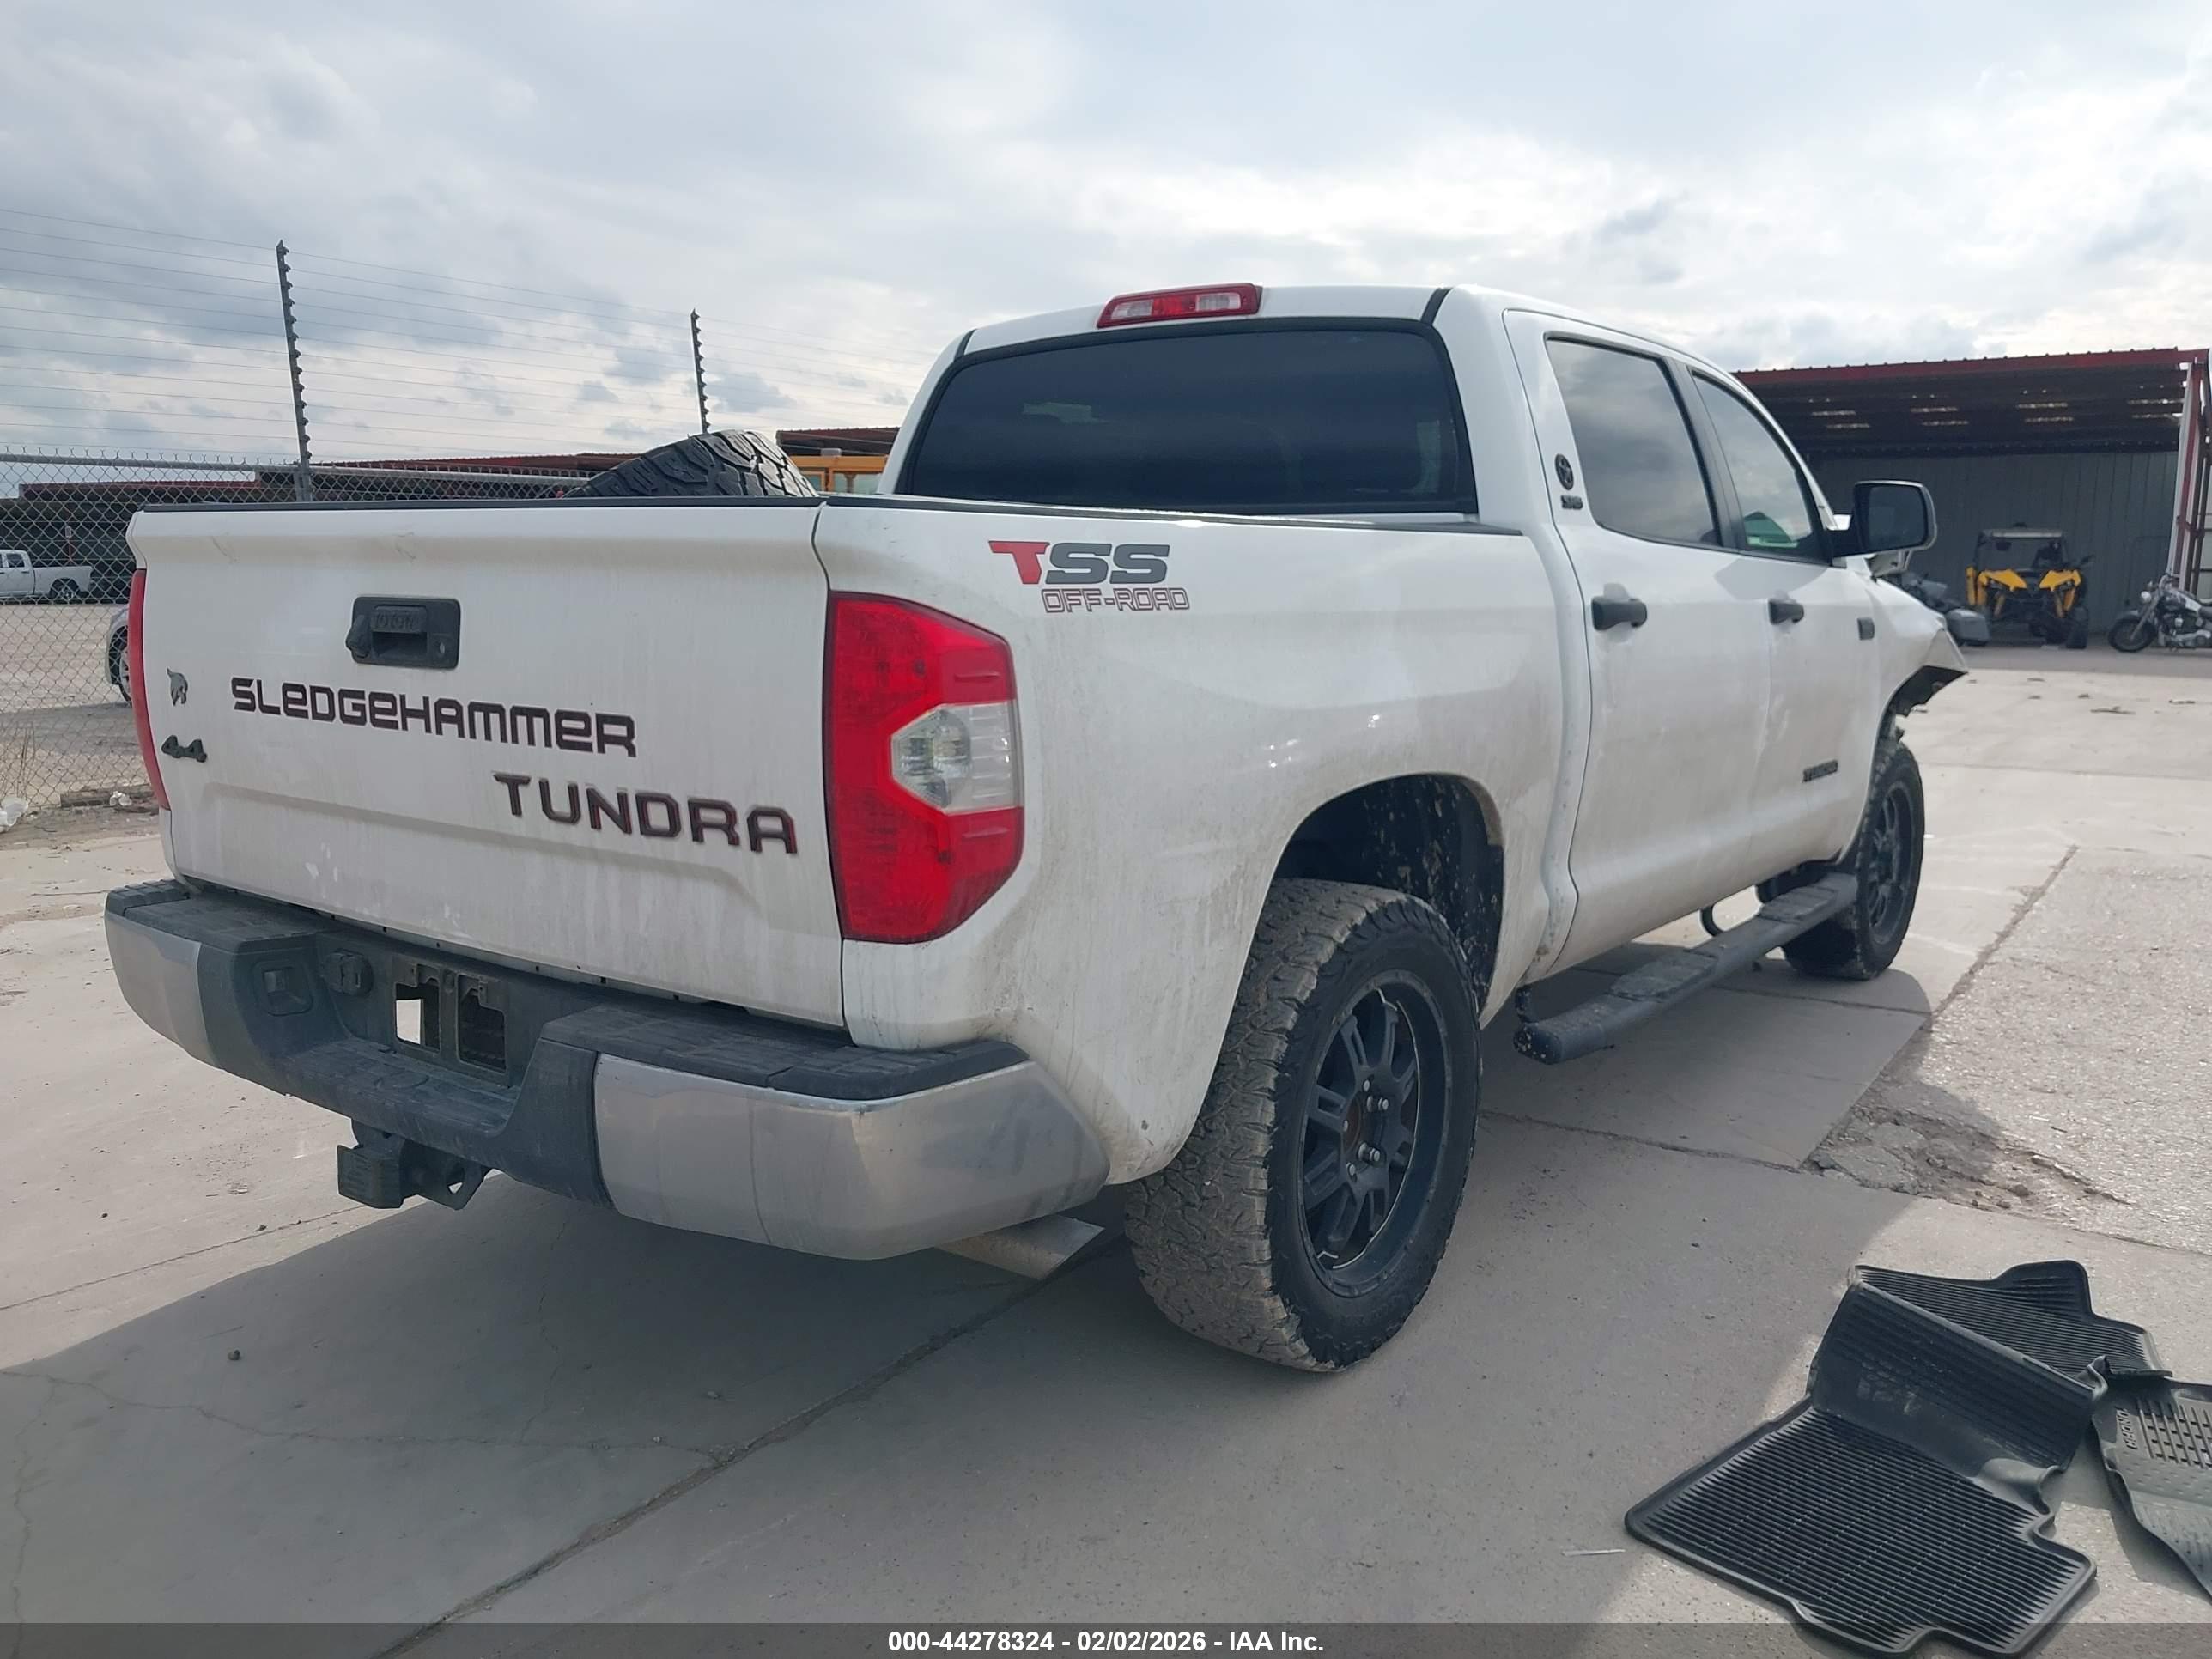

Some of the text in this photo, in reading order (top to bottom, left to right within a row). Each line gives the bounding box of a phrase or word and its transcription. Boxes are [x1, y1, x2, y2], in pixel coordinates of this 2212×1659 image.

[988, 540, 1170, 585] TSS
[1041, 587, 1190, 613] OFF-ROAD
[493, 773, 798, 854] TUNDRA
